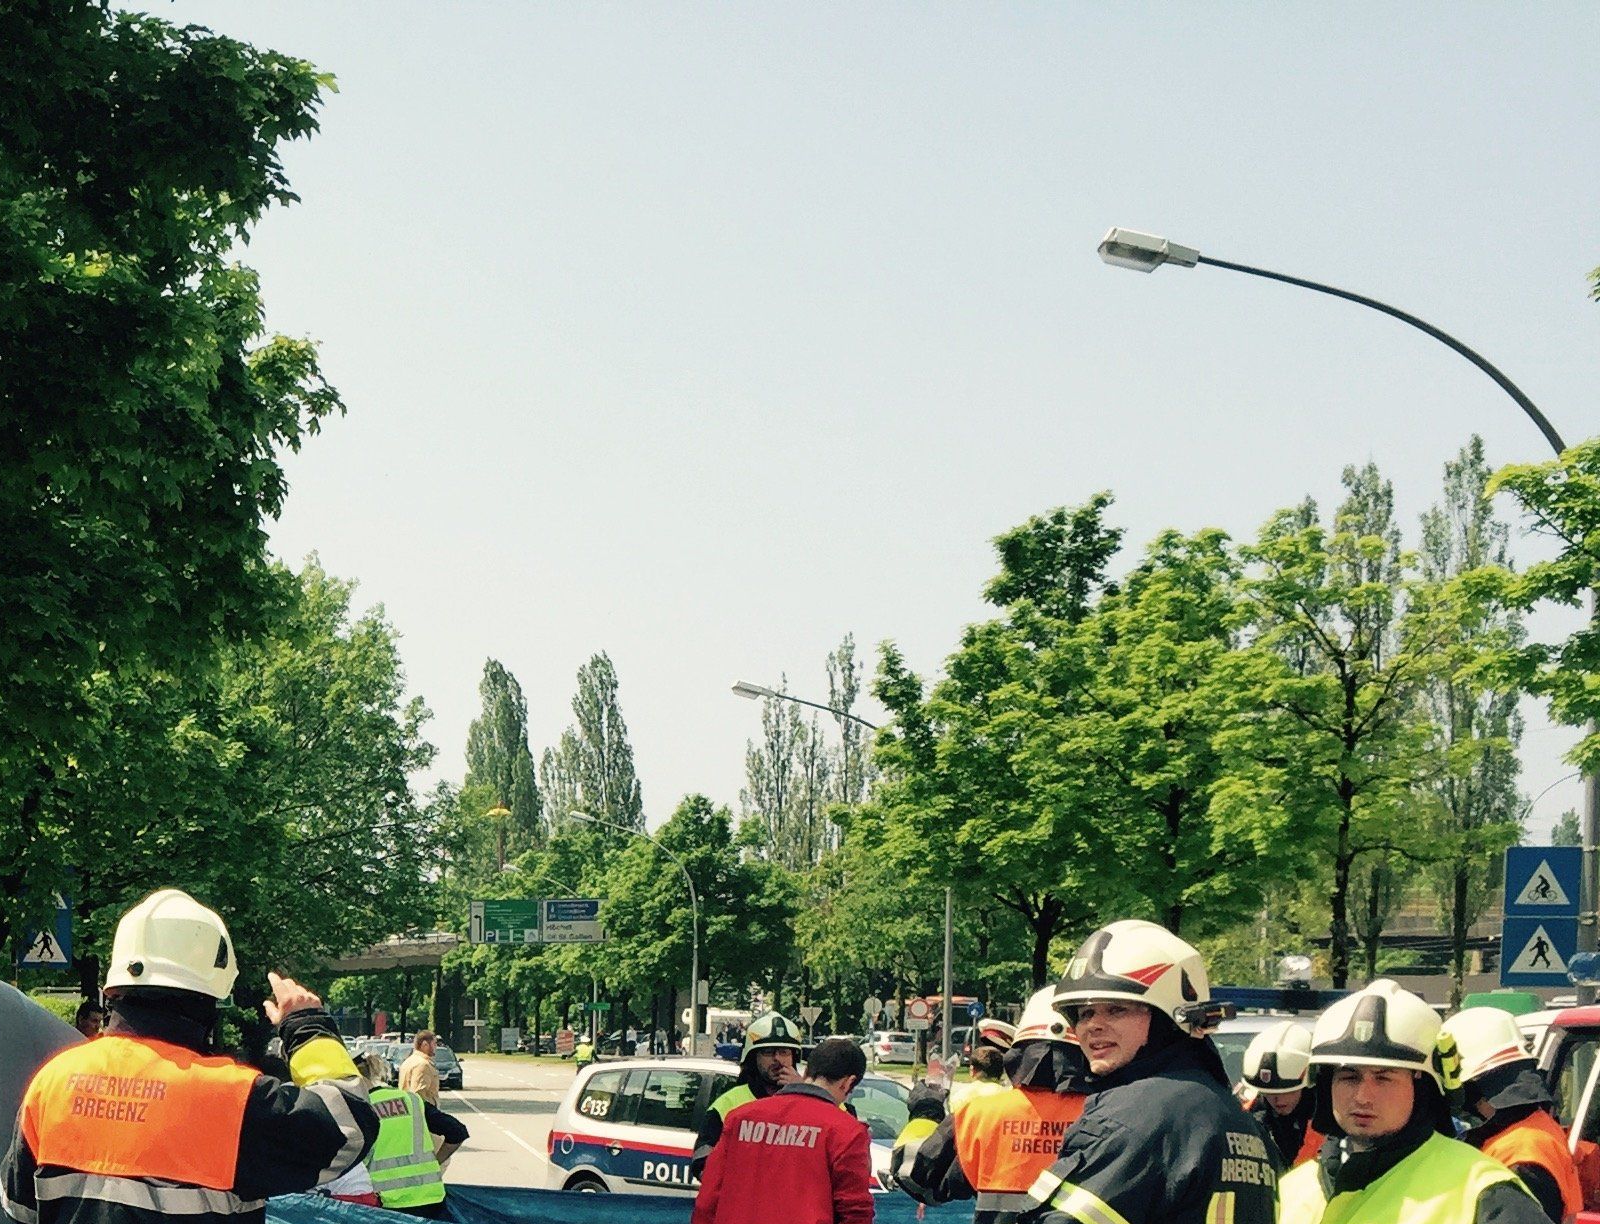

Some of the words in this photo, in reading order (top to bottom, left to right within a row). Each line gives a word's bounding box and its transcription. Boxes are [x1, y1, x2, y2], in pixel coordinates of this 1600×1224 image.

[67, 1073, 166, 1100] FEUERWEHR
[71, 1096, 148, 1122] BREGENZ
[375, 1097, 409, 1118] LIZEI
[589, 1100, 609, 1116] 133
[738, 1119, 822, 1148] NOTARZT
[643, 1160, 701, 1186] POLI
